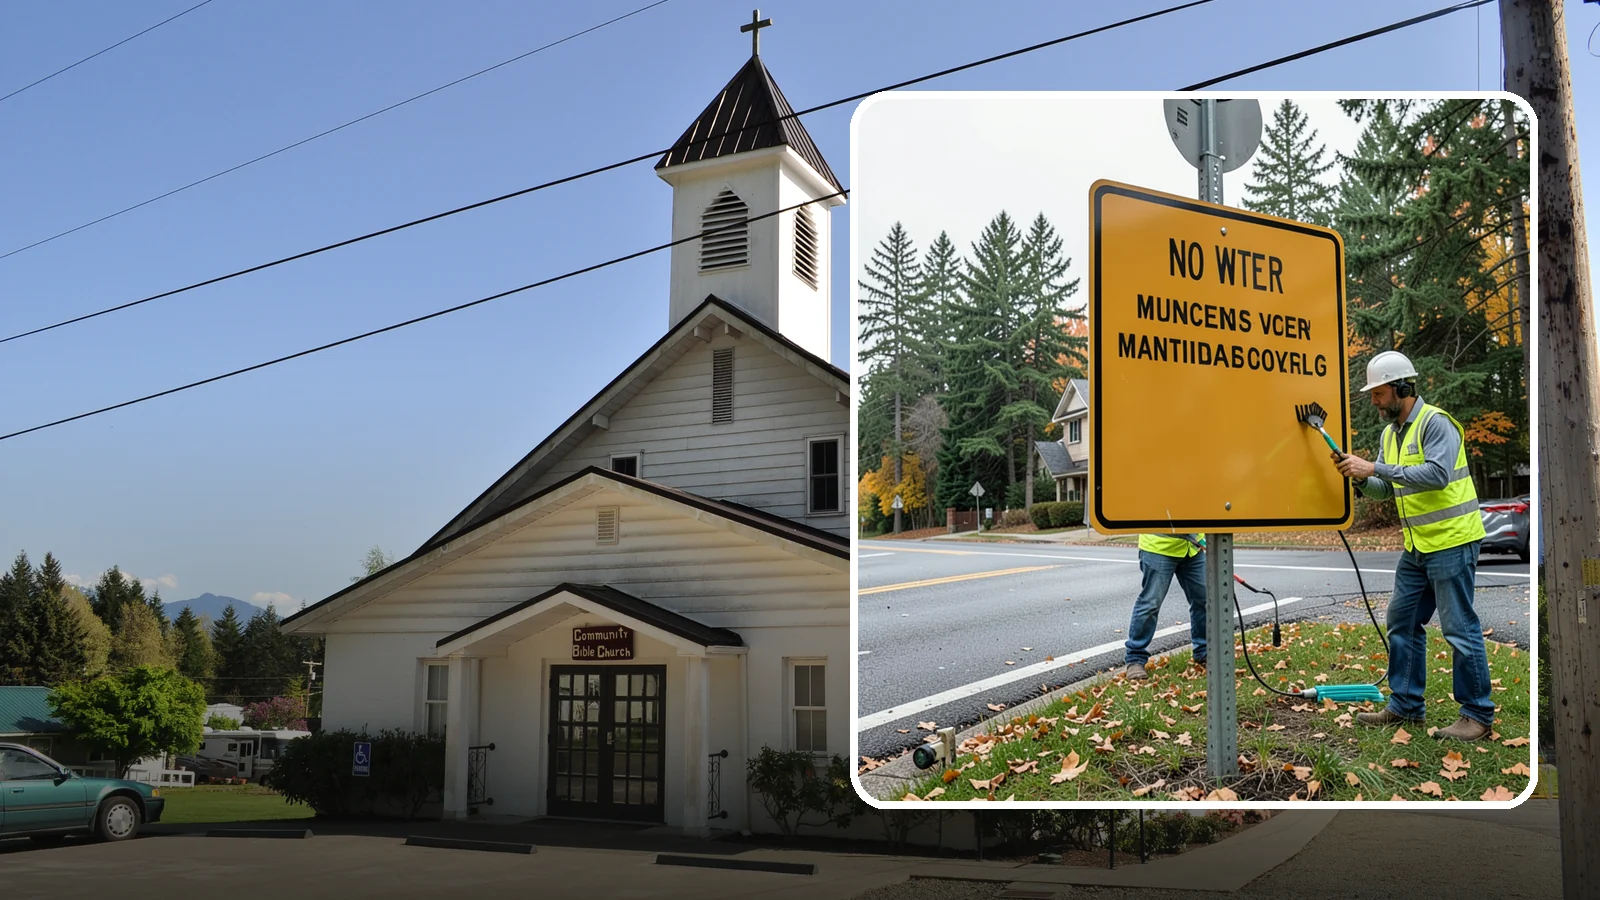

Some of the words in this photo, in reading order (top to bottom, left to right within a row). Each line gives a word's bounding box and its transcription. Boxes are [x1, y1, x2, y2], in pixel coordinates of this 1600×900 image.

[1169, 238, 1204, 281] NO
[1215, 245, 1283, 294] WTER
[1137, 294, 1252, 333] MUNCENS
[574, 627, 628, 642] Community
[572, 644, 595, 657] Bible
[597, 645, 631, 658] Church
